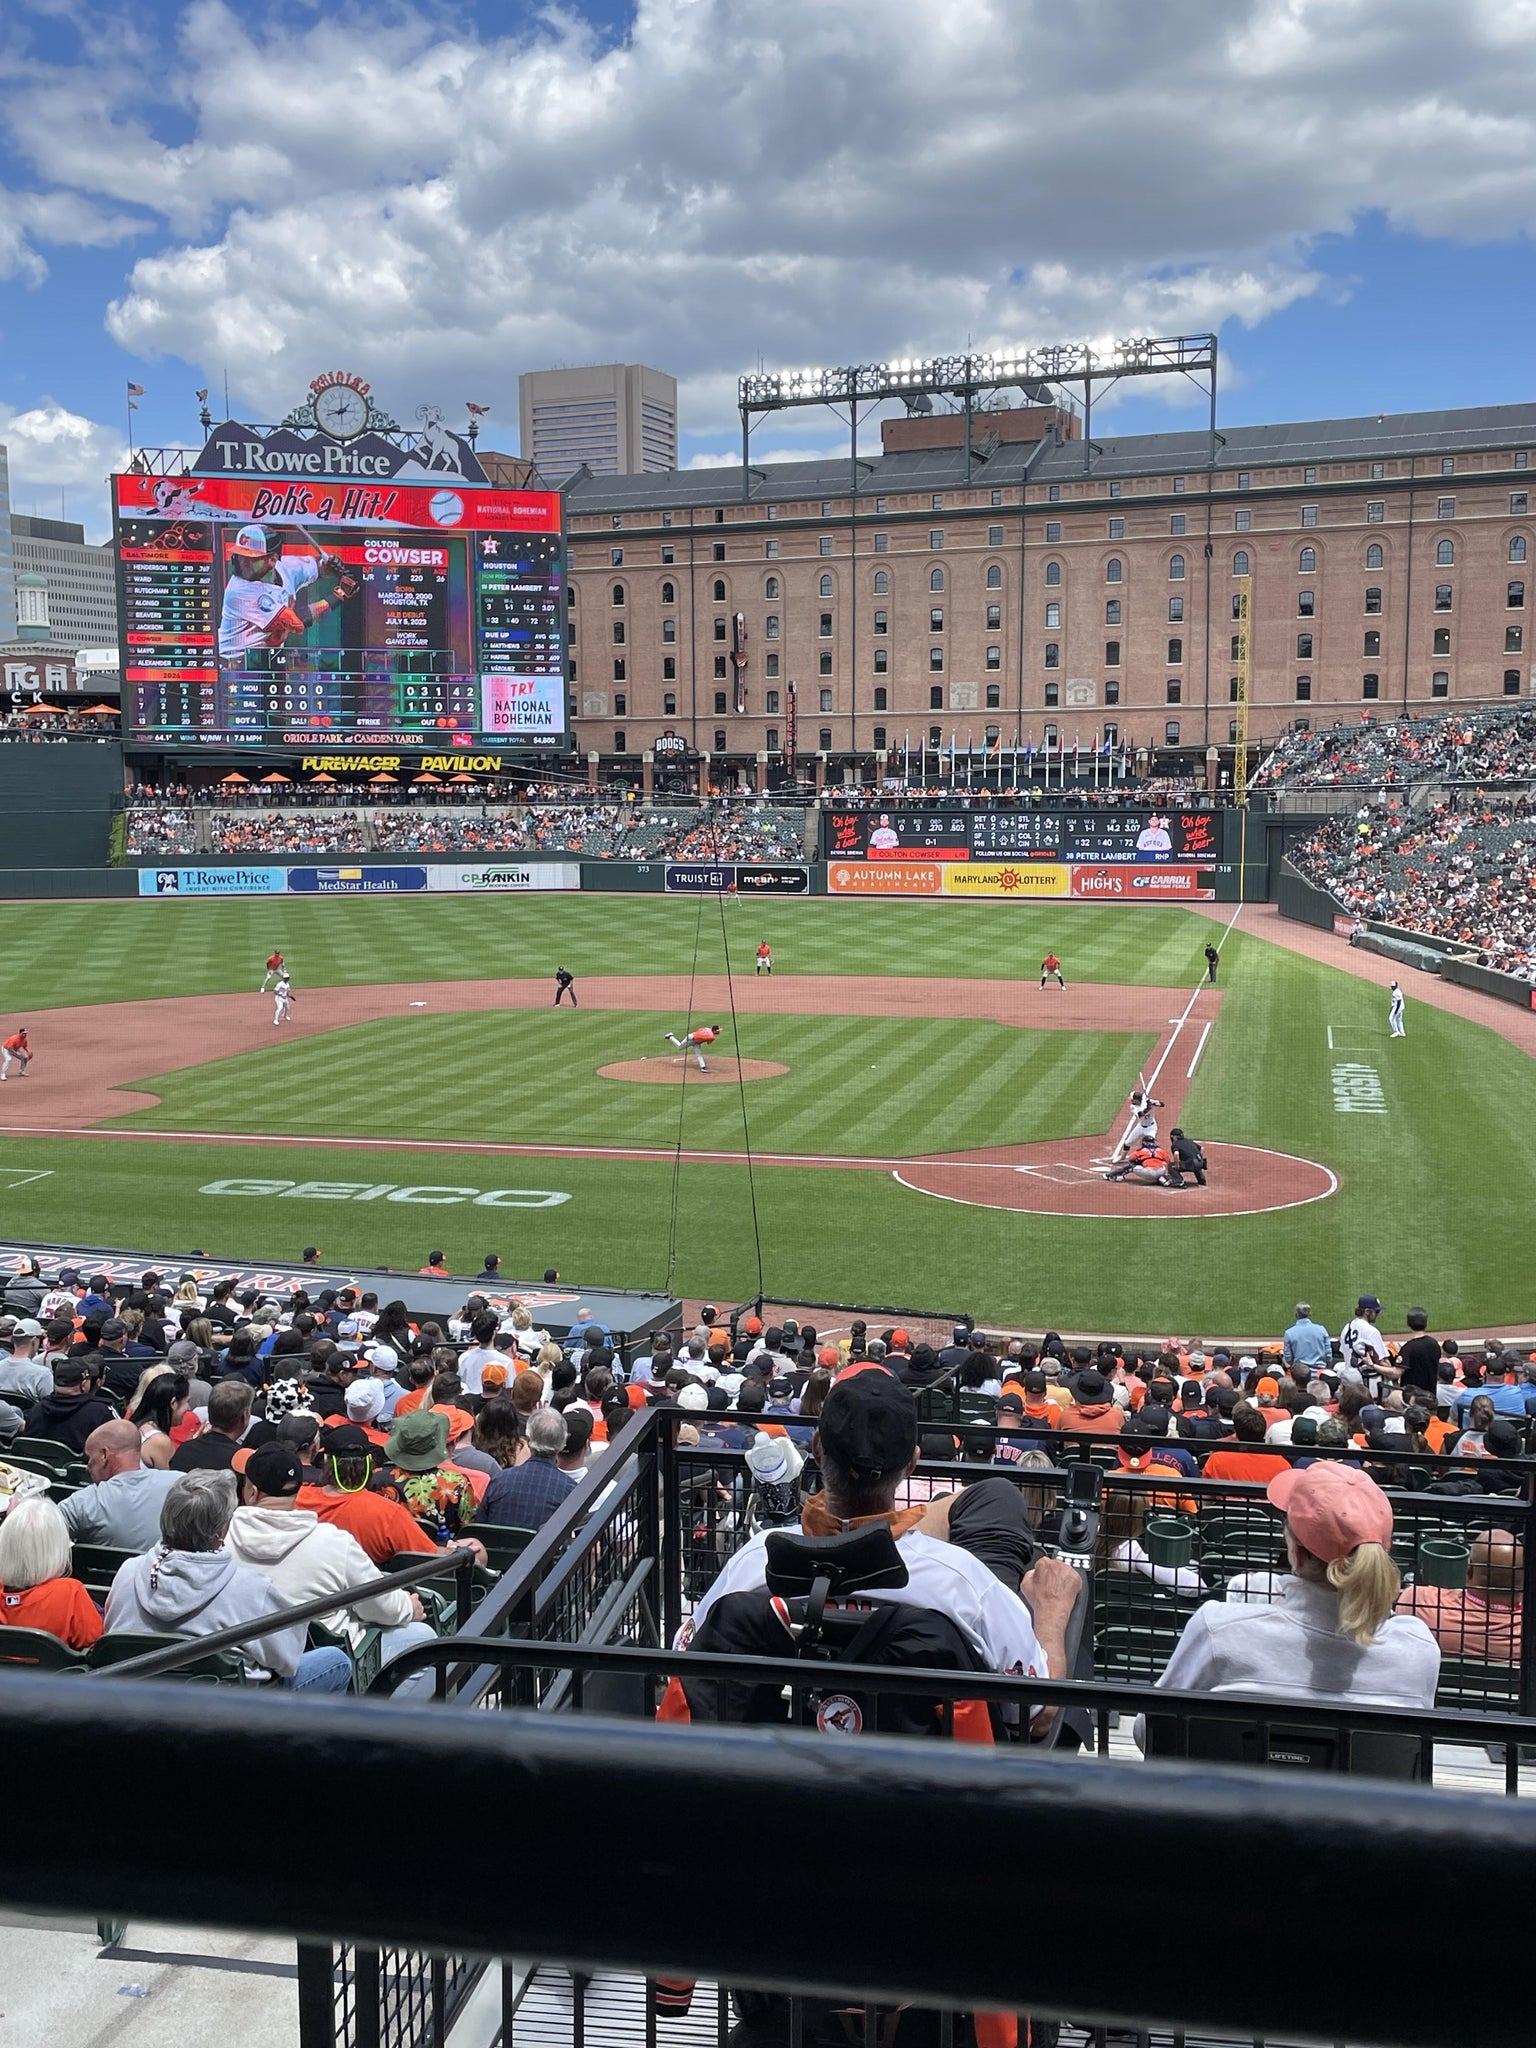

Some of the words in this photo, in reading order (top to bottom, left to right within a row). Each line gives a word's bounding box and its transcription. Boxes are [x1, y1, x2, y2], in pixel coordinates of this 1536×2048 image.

[252, 485, 313, 519] Boh's
[317, 498, 333, 521] a
[340, 488, 397, 521] Hit!
[477, 505, 510, 514] NATIONAL
[513, 506, 547, 515] BOHEMIAN
[364, 540, 399, 548] COLTON
[365, 548, 443, 565] COWSER
[483, 562, 517, 570] HOUSTON
[269, 685, 277, 694] 0
[284, 685, 292, 694] 0
[299, 685, 306, 694] 0
[315, 685, 323, 695] 0
[407, 687, 414, 695] 0
[421, 687, 428, 696] 3
[453, 687, 460, 696] 4
[467, 687, 474, 696] 2
[511, 681, 535, 697] TRY
[270, 700, 278, 710] 0
[285, 700, 293, 710] 0
[299, 700, 307, 710] 0
[408, 702, 414, 711] 1
[422, 702, 428, 711] 1
[435, 702, 443, 712] 0
[453, 703, 461, 712] 4
[467, 703, 474, 712] 2
[495, 701, 551, 712] NATIONAL
[494, 713, 552, 725] BOHEMIAN
[283, 734, 318, 743] ORIOLE
[318, 734, 343, 743] PARK
[354, 734, 393, 744] CAMDEN
[394, 735, 424, 744] YARDS
[302, 756, 400, 771] PUREWAGER
[420, 756, 501, 771] PAVILION
[915, 824, 921, 832] 3
[1076, 852, 1100, 860] PETER
[1101, 852, 1137, 860] LAMBERT
[482, 873, 529, 883] RANKIN
[675, 873, 709, 883] TRUIST
[853, 871, 902, 880] AUTUMN
[906, 871, 934, 881] LAKE
[954, 875, 999, 884] MARYLAND
[1019, 876, 1057, 885] LOTTERY
[1151, 876, 1192, 885] CARROLL
[318, 880, 359, 891] MedStar
[363, 879, 399, 889] Health
[1081, 877, 1123, 893] HIGH'S
[198, 1178, 573, 1207] GEICO
[1344, 1328, 1359, 1349] 42
[1270, 1753, 1305, 1761] LIFETIME
